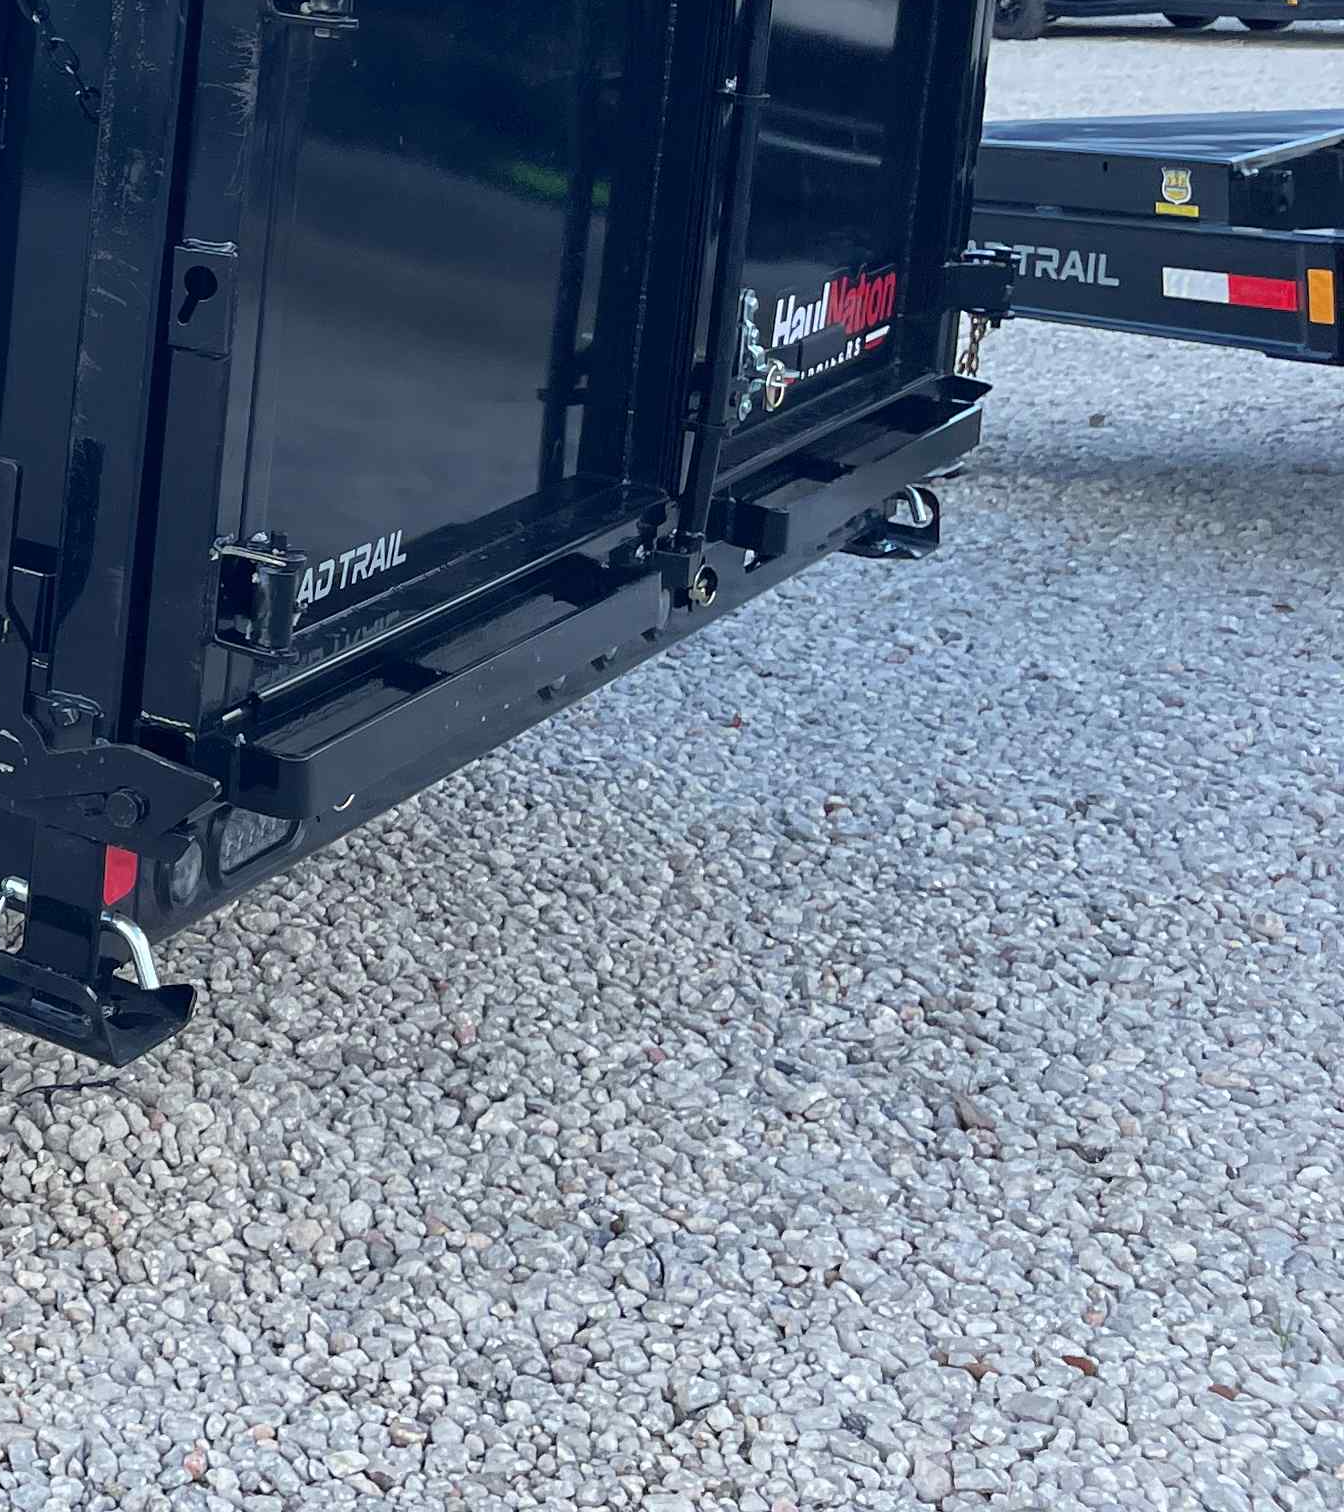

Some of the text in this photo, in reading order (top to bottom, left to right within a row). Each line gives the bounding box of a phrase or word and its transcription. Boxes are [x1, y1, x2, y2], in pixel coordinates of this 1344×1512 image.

[1013, 245, 1120, 287] TRAIL
[296, 529, 407, 604] AD TRAIL
